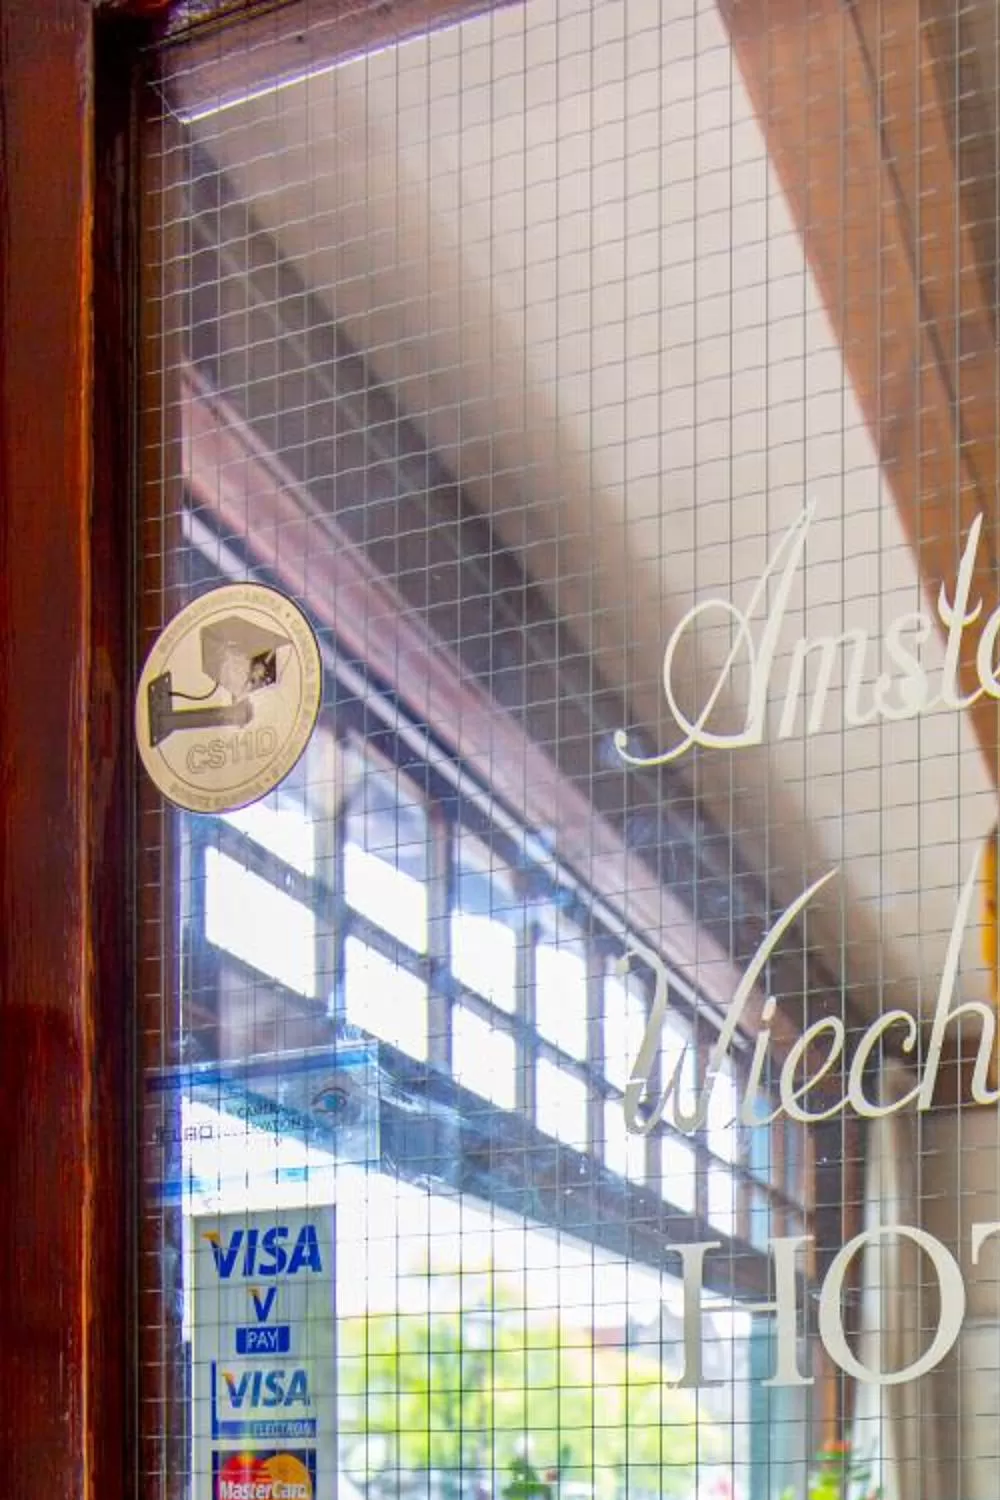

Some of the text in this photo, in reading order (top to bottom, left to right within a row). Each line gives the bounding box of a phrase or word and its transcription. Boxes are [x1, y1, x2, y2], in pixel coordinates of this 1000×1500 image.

[202, 1224, 323, 1279] VISA
[247, 1330, 279, 1350] PAY
[221, 1368, 311, 1409] VISA
[219, 1479, 307, 1500] MasterCard
